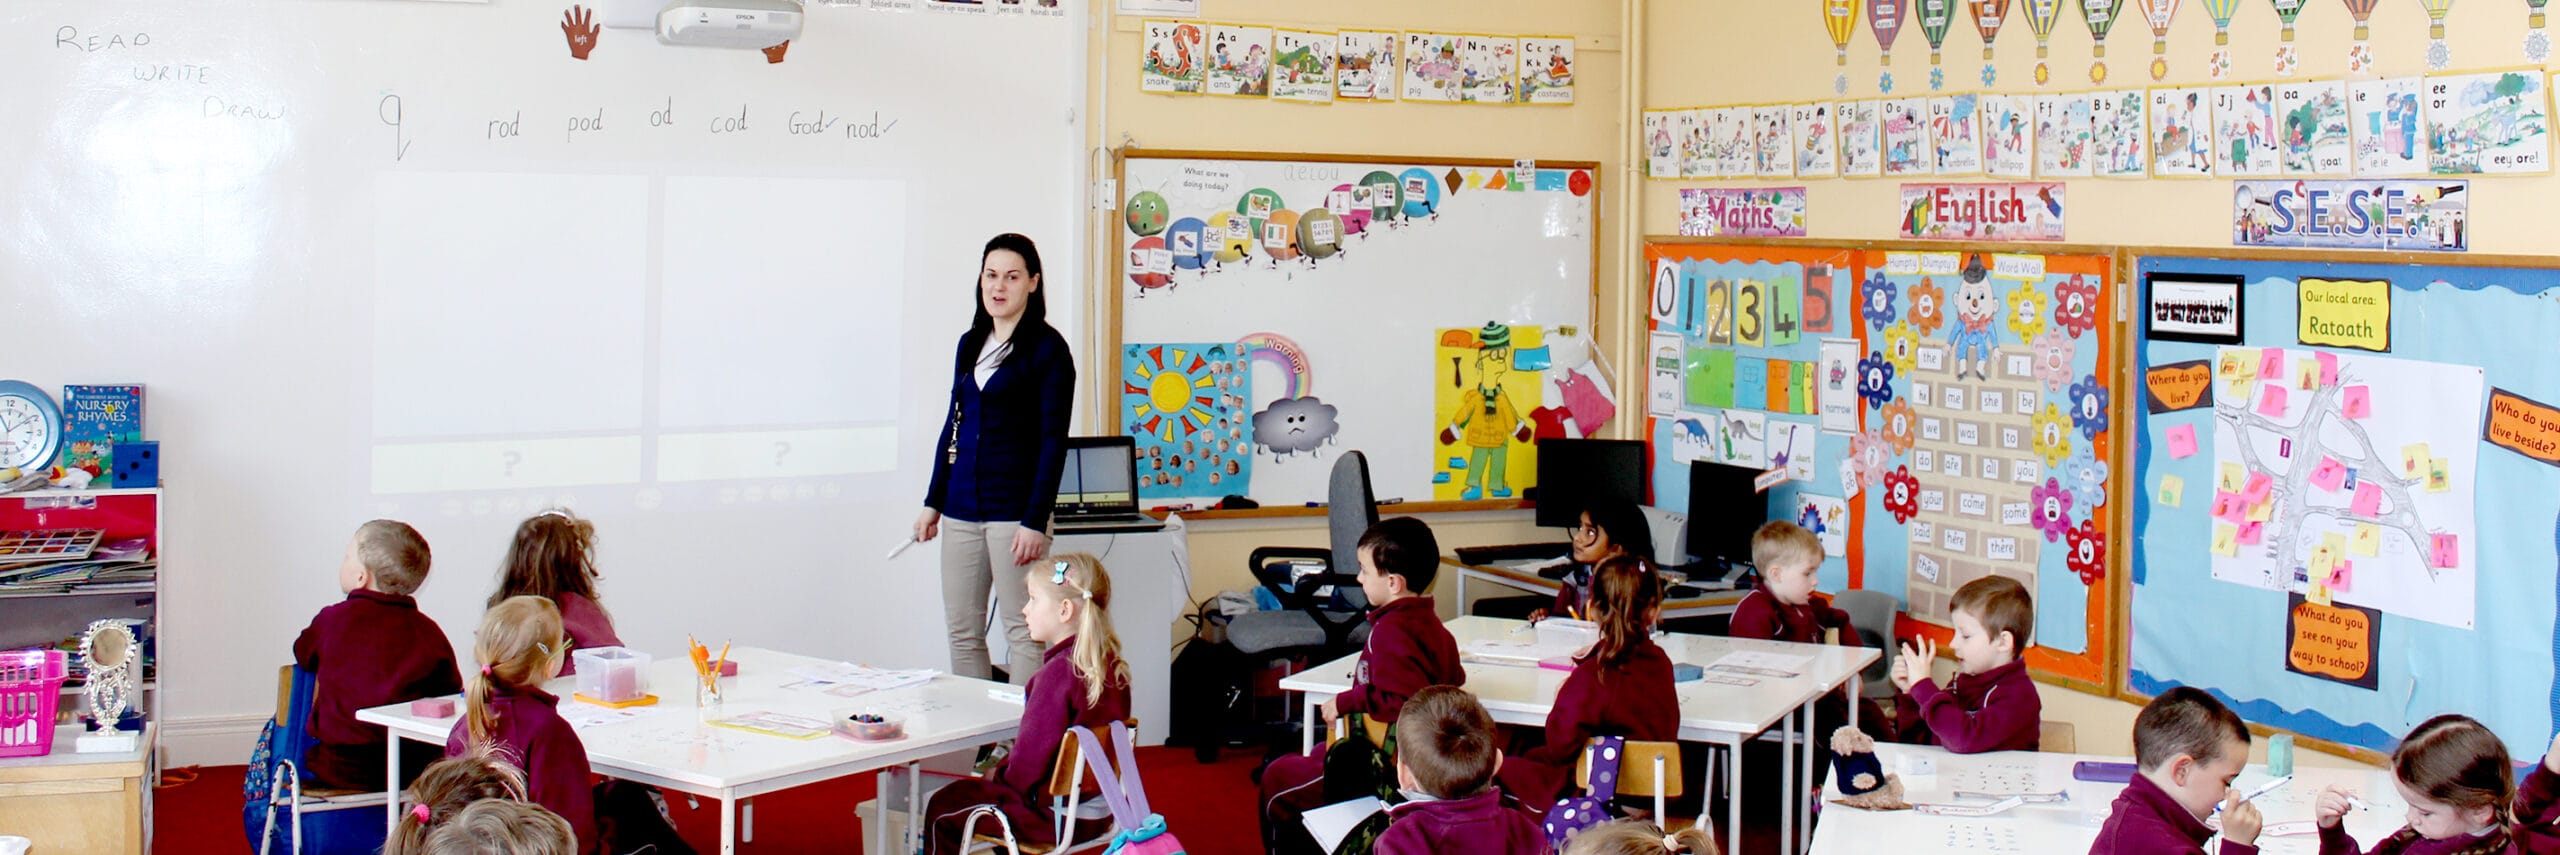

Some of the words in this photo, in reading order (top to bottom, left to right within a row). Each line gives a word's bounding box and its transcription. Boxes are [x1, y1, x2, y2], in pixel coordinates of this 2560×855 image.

[927, 3, 946, 11] hand
[967, 6, 986, 14] speak
[56, 25, 151, 52] READ
[1152, 27, 1159, 38] S
[1217, 31, 1226, 41] A
[1230, 34, 1237, 42] a
[573, 34, 588, 45] left
[1283, 37, 1290, 47] T
[1411, 35, 1419, 45] P
[1423, 39, 1430, 49] p
[1467, 41, 1477, 51] N
[1481, 44, 1487, 52] n
[1525, 42, 1533, 52] C
[1526, 59, 1533, 67] K
[133, 64, 212, 85] WRITE
[1145, 77, 1171, 87] snake
[1213, 81, 1231, 90] ants
[1306, 87, 1329, 97] tennis
[1409, 87, 1422, 97] pig
[1483, 90, 1496, 98] net
[1537, 90, 1571, 98] castanets
[2433, 84, 2447, 94] ee
[2156, 93, 2167, 105] ai
[2217, 94, 2225, 107] J
[2284, 91, 2299, 101] oa
[2355, 89, 2366, 102] ie
[1933, 104, 1941, 115] U
[1986, 102, 1992, 112] L
[2039, 102, 2045, 113] F
[2094, 99, 2101, 111] B
[2105, 99, 2111, 111] b
[2433, 98, 2446, 109] or
[650, 95, 673, 128] od
[1754, 112, 1761, 121] M
[1763, 113, 1771, 121] m
[1796, 111, 1803, 121] D
[1839, 105, 1845, 116] G
[1847, 107, 1853, 118] g
[710, 103, 749, 134] cod
[788, 110, 824, 136] God
[1681, 116, 1687, 125] H
[1717, 113, 1723, 123] R
[487, 110, 521, 140] rod
[568, 108, 603, 143] pod
[846, 111, 880, 140] nod
[1814, 161, 1831, 169] drum
[1948, 157, 1976, 167] umbrella
[2168, 160, 2185, 168] pain
[2254, 158, 2273, 171] jam
[2320, 157, 2343, 170] goat
[2494, 154, 2512, 168] eey
[2516, 151, 2540, 163] ore!
[1183, 167, 1204, 176] What
[1206, 170, 1217, 178] are
[1701, 162, 1712, 172] hop
[1183, 180, 1203, 190] doing
[1205, 182, 1229, 192] today?
[1709, 194, 1774, 229] Maths
[1935, 187, 2027, 237] English
[2271, 188, 2419, 238] S.E.S.E.
[1888, 256, 1918, 273] Humpty
[1922, 254, 1957, 272] Dumpty's
[1996, 260, 2019, 273] Word
[2021, 261, 2041, 275] Wall
[1806, 267, 1832, 328] 5
[2305, 290, 2323, 302] Our
[2325, 291, 2349, 304] local
[2351, 294, 2377, 306] area:
[1685, 278, 1695, 331] 1
[1708, 280, 1729, 344] 2
[1739, 285, 1762, 342] 3
[1772, 285, 1796, 339] 4
[2309, 316, 2374, 339] Ratoath
[1265, 337, 1305, 376] Warning
[1923, 349, 1937, 361] the
[2149, 372, 2177, 386] Where
[2178, 371, 2191, 383] do
[2193, 371, 2210, 389] you
[1657, 391, 1674, 401] wide
[1947, 393, 1961, 402] me
[1984, 394, 1999, 407] she
[2022, 393, 2033, 405] be
[2170, 390, 2191, 403] live?
[6, 399, 16, 407] 12
[1825, 404, 1851, 414] narrow
[78, 411, 127, 422] RHYMES
[2495, 398, 2520, 419] Who
[2523, 410, 2536, 424] do
[1925, 426, 1938, 434] we
[1960, 428, 1976, 439] was
[2005, 431, 2017, 442] to
[2493, 422, 2512, 440] live
[2514, 430, 2556, 455] beside?
[1919, 453, 1930, 466] do
[1945, 461, 1959, 470] are
[1985, 463, 1997, 474] all
[2016, 465, 2034, 480] you
[1923, 495, 1942, 509] your
[1962, 498, 1985, 510] come
[2004, 508, 2028, 519] some
[1914, 525, 1931, 538] said
[1946, 531, 1964, 546] here
[1991, 541, 2014, 552] there
[1918, 557, 1937, 581] they
[2300, 606, 2326, 623] What
[2329, 612, 2342, 625] do
[2345, 618, 2364, 630] you
[2302, 630, 2318, 641] see
[2320, 633, 2333, 646] on
[2335, 637, 2358, 651] your
[2293, 650, 2314, 666] way
[2316, 653, 2327, 665] to
[2329, 654, 2365, 674] school?
